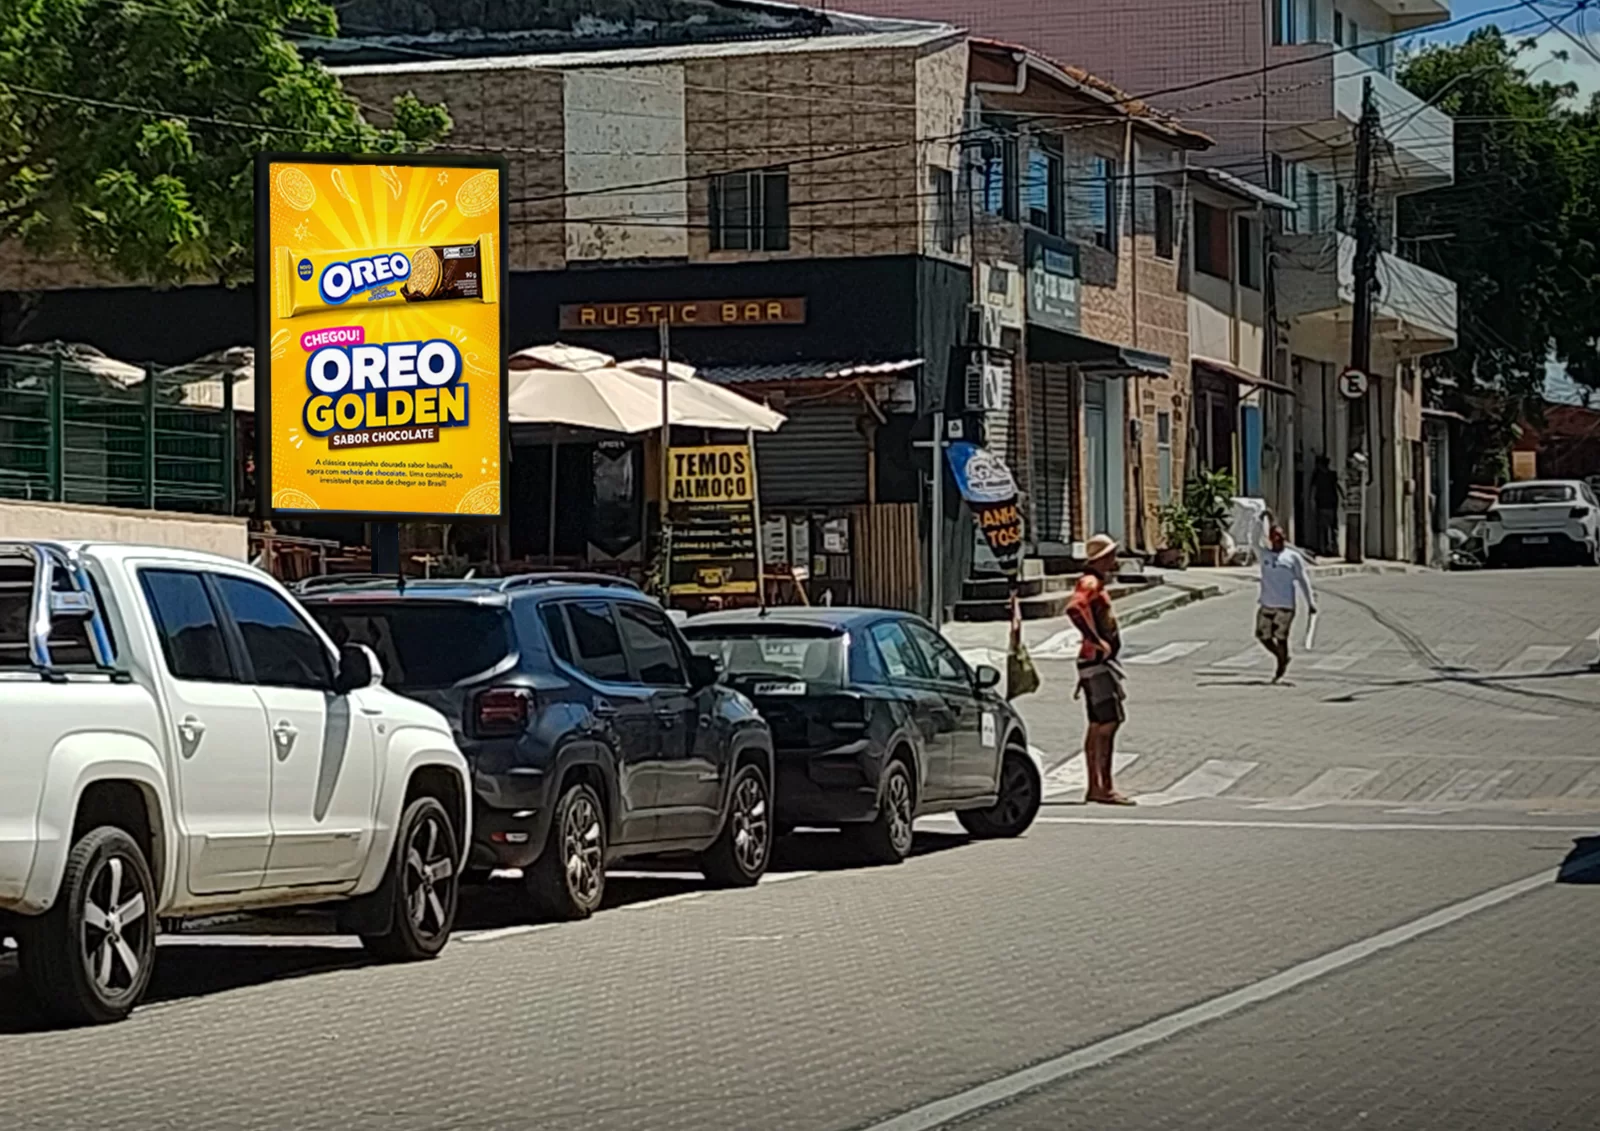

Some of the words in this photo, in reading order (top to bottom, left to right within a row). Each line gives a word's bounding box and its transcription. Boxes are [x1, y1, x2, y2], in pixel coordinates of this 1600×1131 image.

[322, 254, 409, 298] OREO
[580, 305, 697, 325] RUSTIC
[722, 302, 784, 322] BAR
[304, 330, 360, 347] CHEGOU!
[310, 342, 456, 393] OREO
[306, 386, 465, 432] GOLDEN
[333, 433, 369, 446] SABOR
[372, 428, 434, 443] CHOCOLATE
[340, 468, 364, 476] recheio
[348, 460, 380, 468] casquinha
[380, 460, 406, 468] dourada
[674, 452, 746, 477] TEMOS
[352, 478, 364, 486] que
[366, 478, 384, 486] acaba
[395, 479, 417, 487] chegar
[983, 505, 1017, 528] ANH
[986, 526, 1020, 548] TOS
